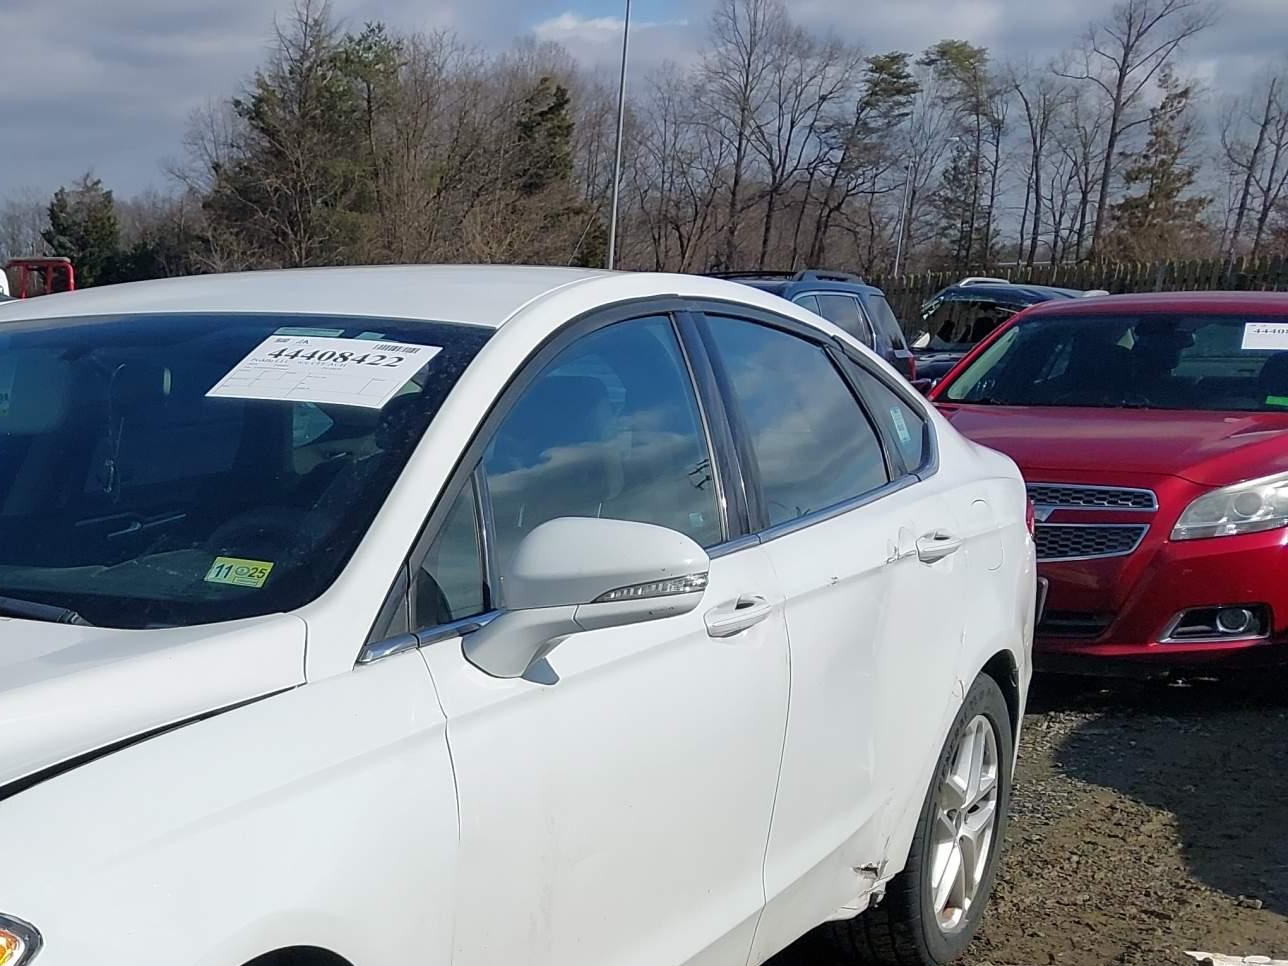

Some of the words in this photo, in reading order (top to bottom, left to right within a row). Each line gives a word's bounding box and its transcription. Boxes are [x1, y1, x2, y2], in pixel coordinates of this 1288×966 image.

[268, 347, 404, 368] 44408422
[214, 563, 233, 579] 11
[247, 566, 268, 579] 25
